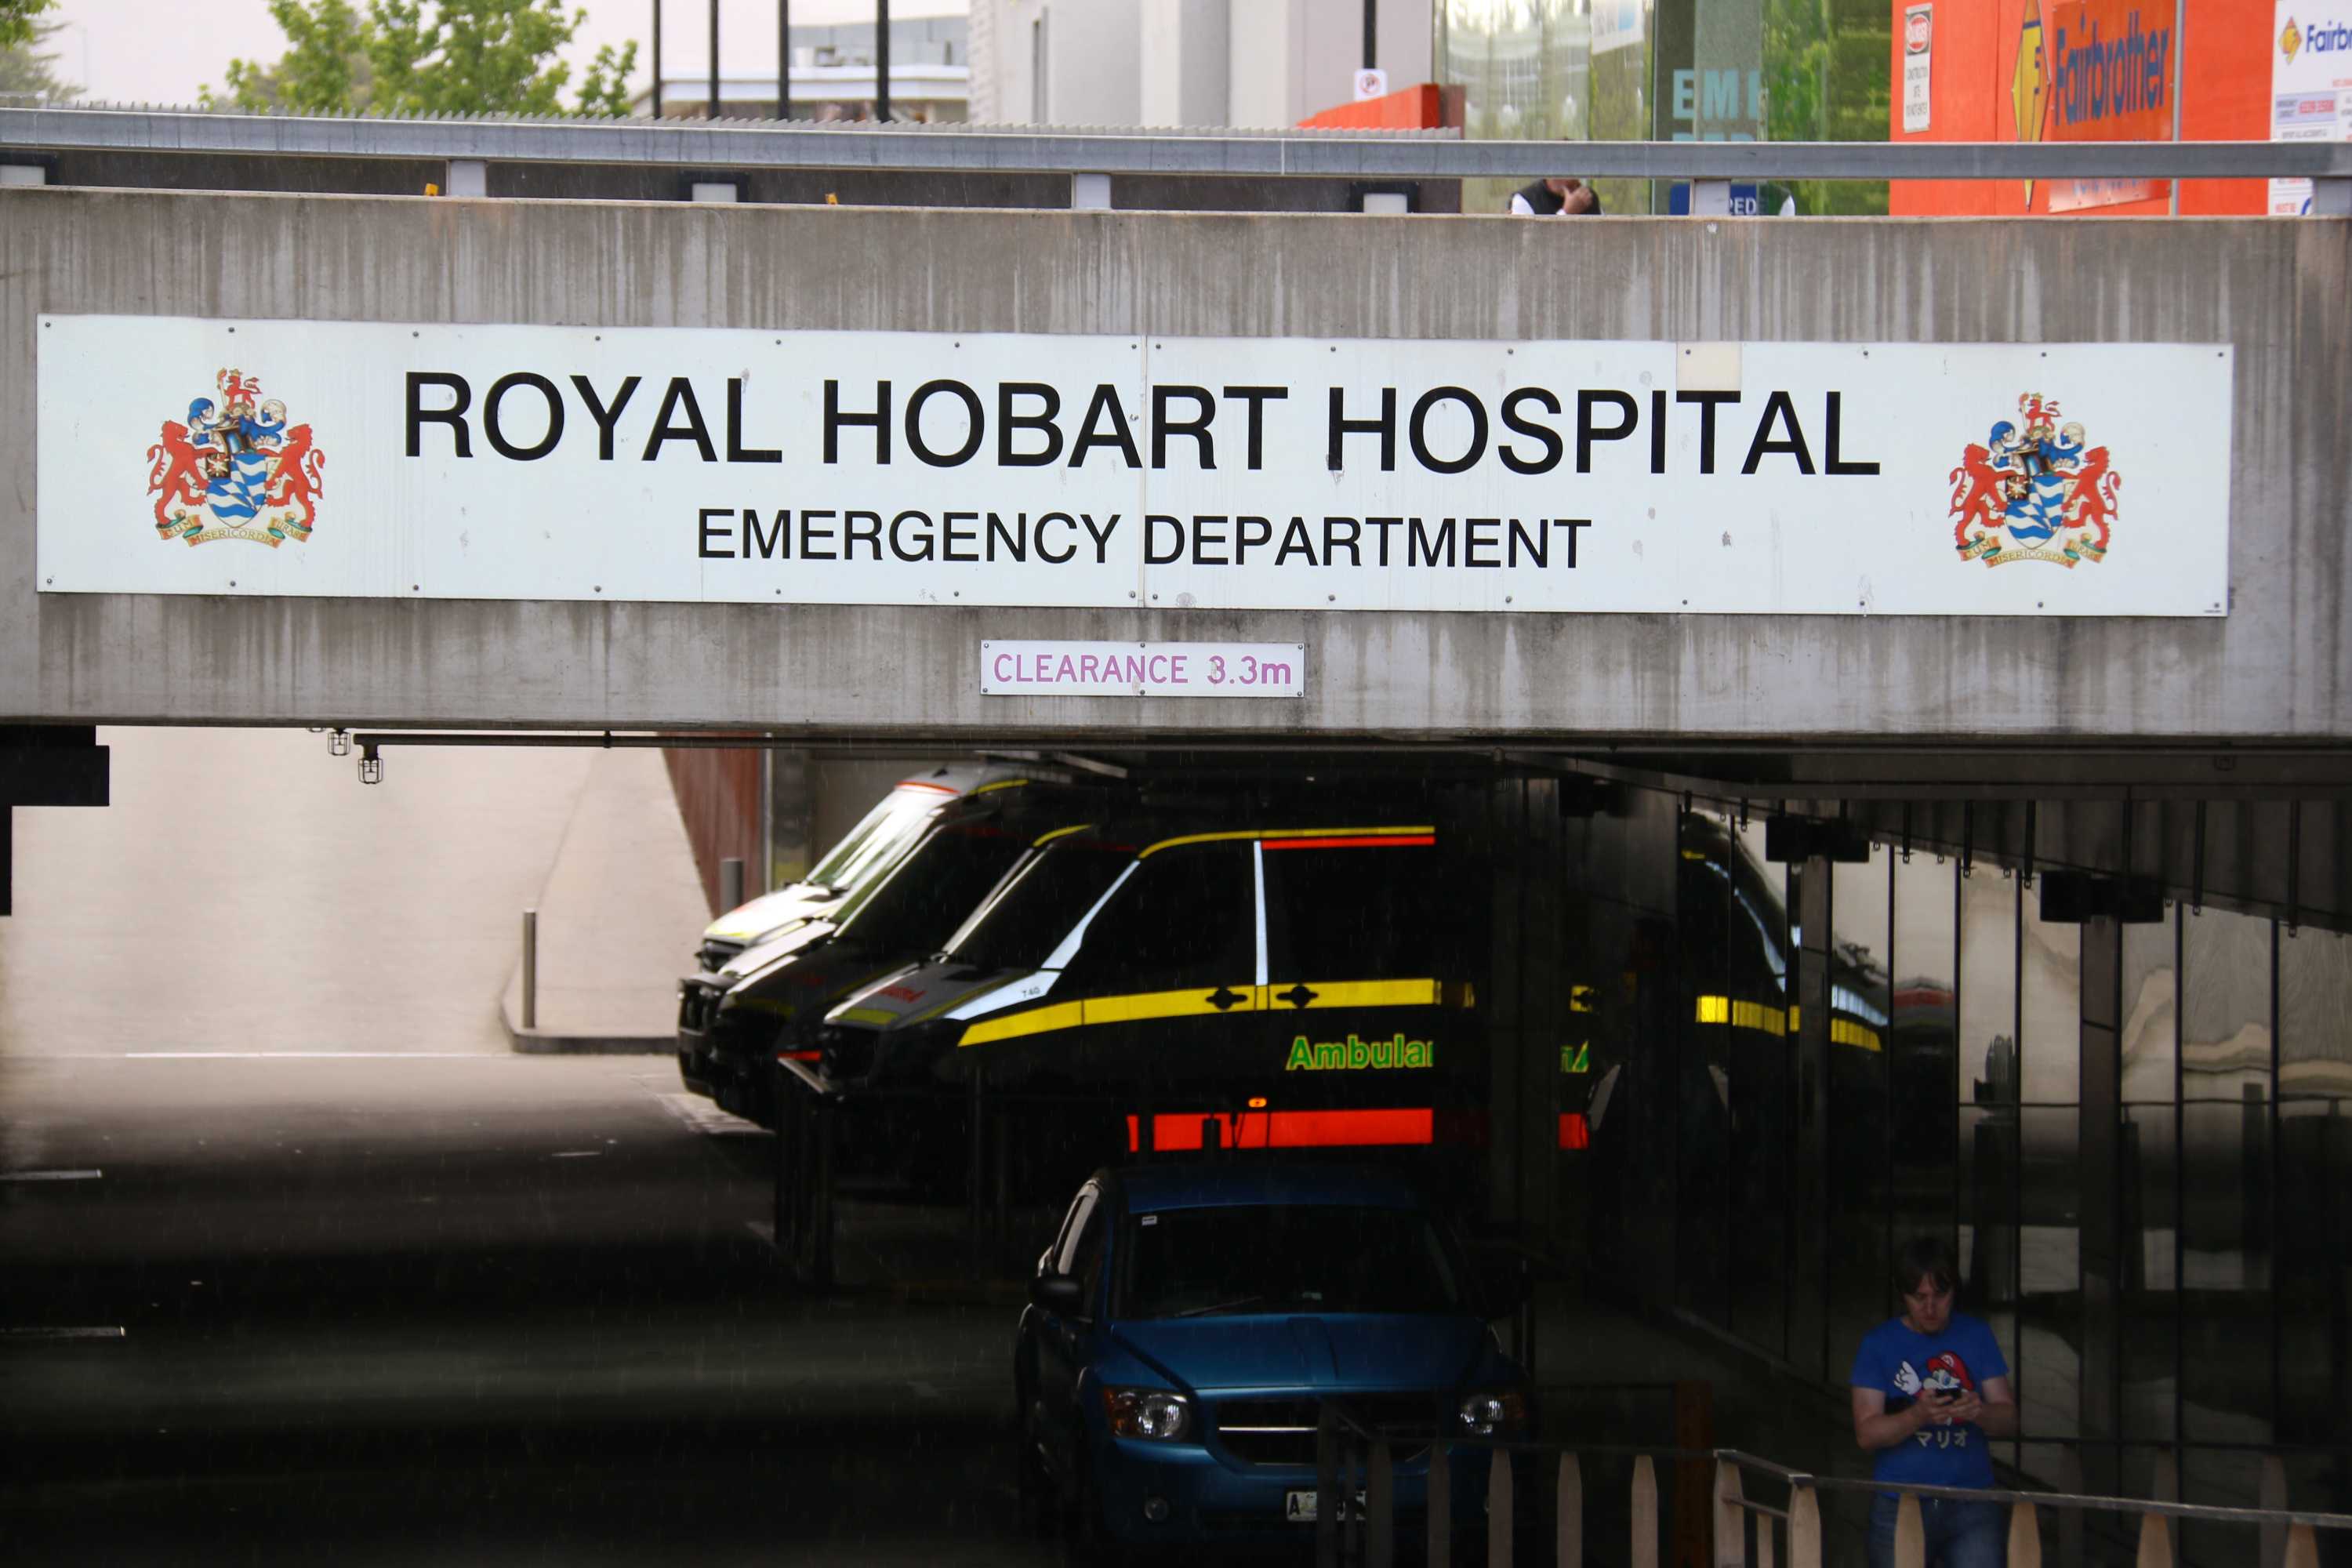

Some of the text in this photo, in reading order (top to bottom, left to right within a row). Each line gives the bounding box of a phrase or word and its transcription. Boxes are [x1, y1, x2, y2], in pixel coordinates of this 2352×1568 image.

[2055, 10, 2170, 126] Fairbrother
[406, 372, 1880, 475] ROYAL HOBART HOSPITAL
[699, 508, 1592, 568] EMERGENCY DEPARTMENT
[993, 653, 1291, 684] CLEARANCE 3.3m
[1915, 1430, 1969, 1449] マリオ
